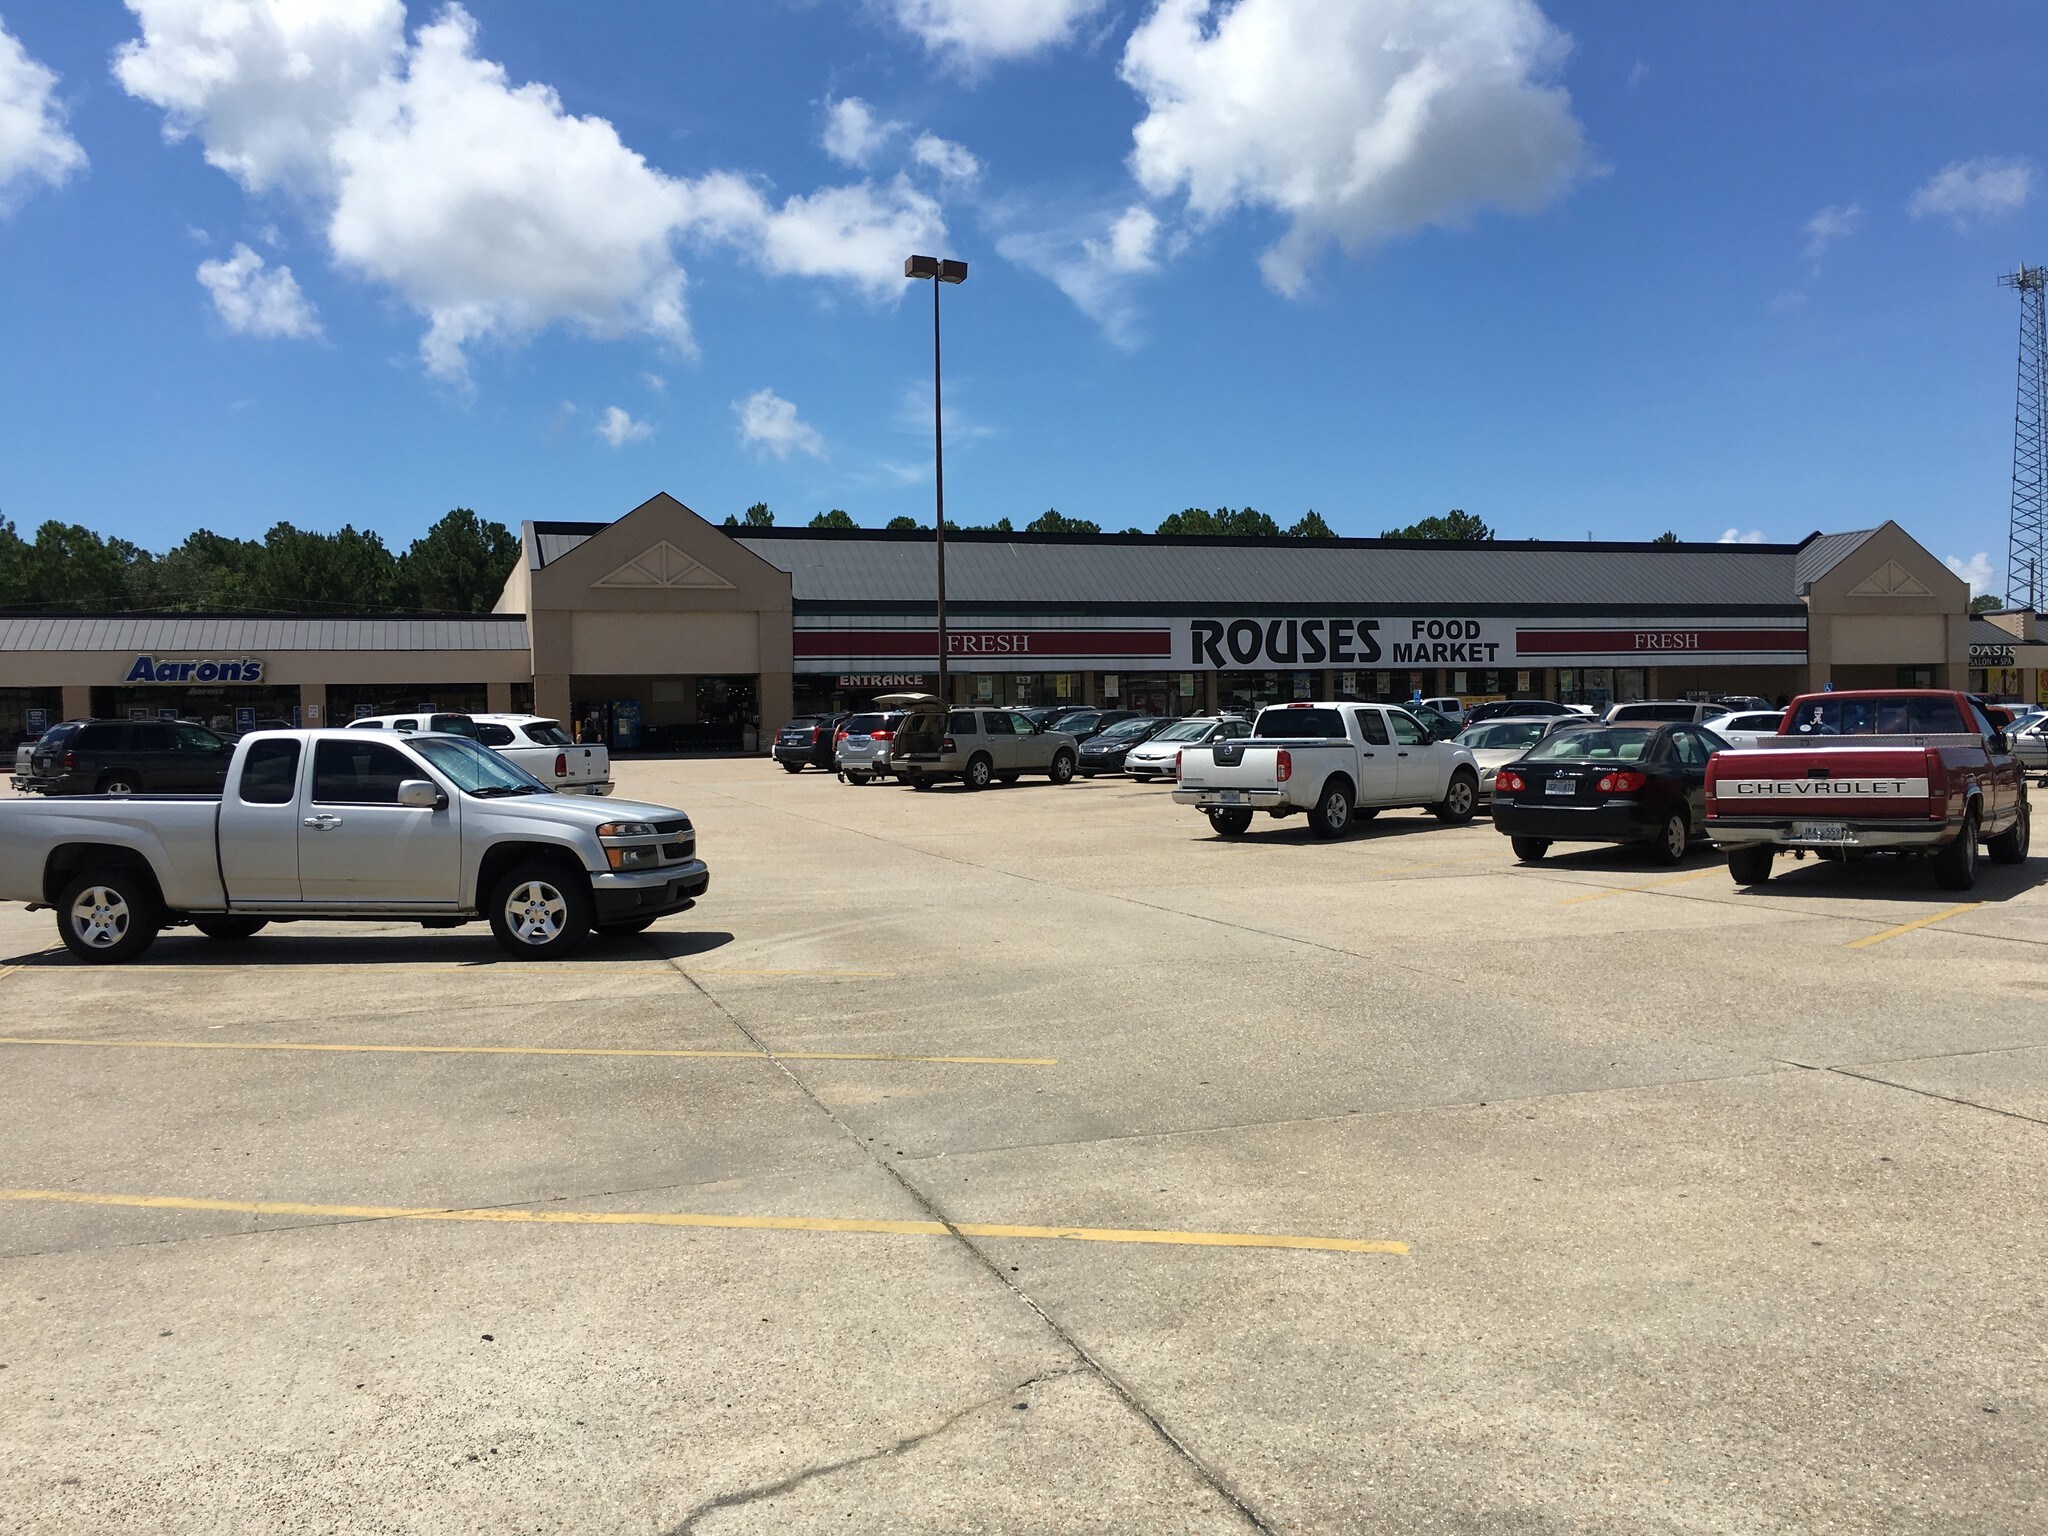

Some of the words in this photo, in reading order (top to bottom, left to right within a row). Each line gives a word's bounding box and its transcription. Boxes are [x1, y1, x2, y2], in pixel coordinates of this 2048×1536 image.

[1411, 620, 1481, 640] FOOD
[946, 635, 1030, 652] FRESH
[1190, 619, 1382, 669] ROUSES
[1634, 633, 1699, 649] FRESH
[1393, 643, 1500, 663] MARKET
[1969, 645, 2017, 656] OASIS
[125, 655, 261, 682] Aaron's
[1969, 657, 1993, 666] SALON
[2000, 657, 2012, 666] SPA
[840, 674, 924, 687] ENTRANCE
[1737, 782, 1907, 794] CHEVROLET
